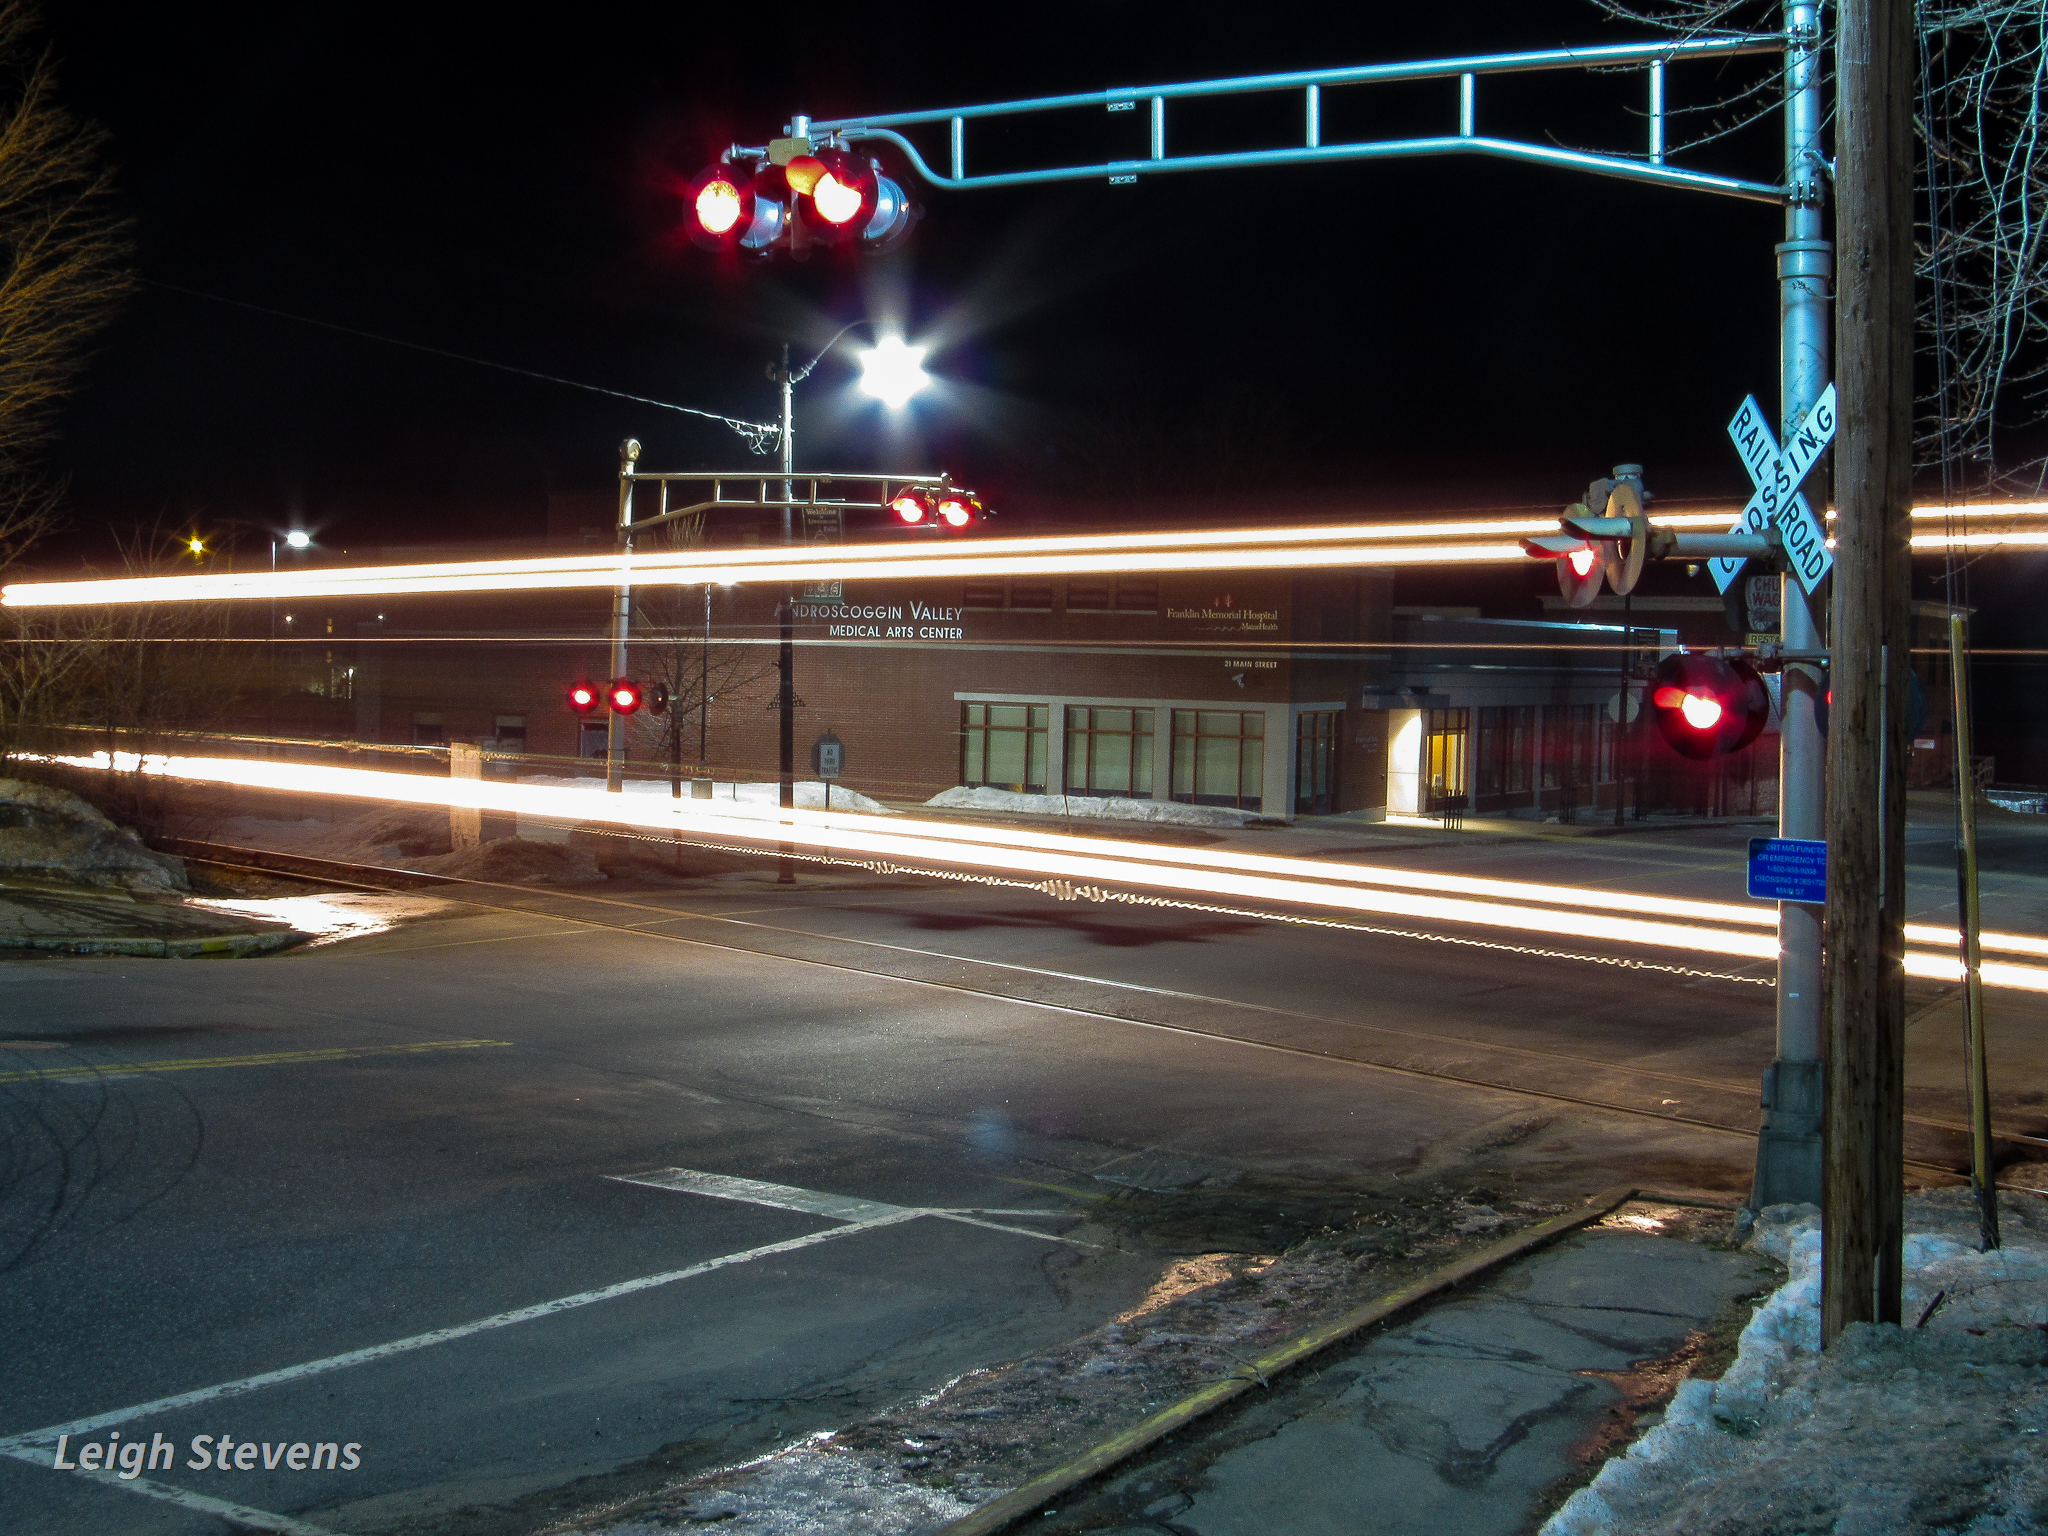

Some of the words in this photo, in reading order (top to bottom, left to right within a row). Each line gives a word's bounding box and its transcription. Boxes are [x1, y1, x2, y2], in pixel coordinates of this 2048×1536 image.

[1720, 405, 1833, 574] COSSING
[1734, 406, 1770, 481] RAIL
[1780, 500, 1824, 580] ROAD
[1754, 577, 1780, 592] CHU
[1753, 593, 1780, 607] WAG
[1167, 608, 1200, 619] Franklin
[1201, 609, 1242, 620] Memorial
[1243, 609, 1278, 622] Hospital
[829, 625, 881, 638] MEDICAL
[886, 625, 914, 638] ARTS
[919, 626, 963, 639] CENTER
[1752, 635, 1782, 645] RESTA
[1782, 844, 1827, 854] MALFUNCTIO
[1757, 853, 1768, 861] OR
[1769, 855, 1815, 864] EMERGENCY
[1754, 875, 1792, 884] CROSSING
[1776, 887, 1794, 895] MAIN
